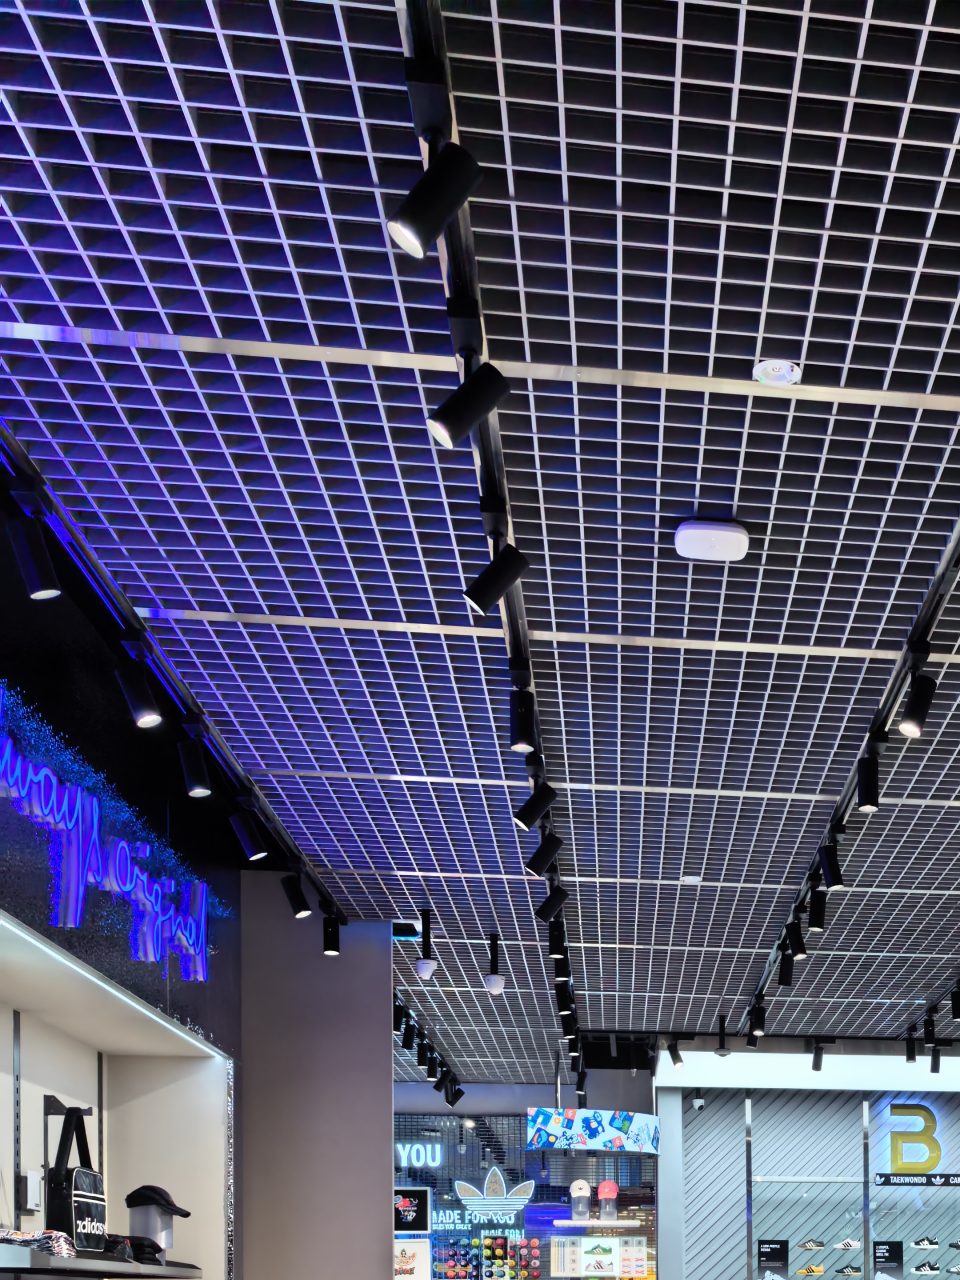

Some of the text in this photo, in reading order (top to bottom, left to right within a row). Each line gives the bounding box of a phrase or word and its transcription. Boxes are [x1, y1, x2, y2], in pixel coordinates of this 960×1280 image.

[396, 1143, 441, 1167] YOU
[890, 1175, 927, 1184] TAEKWONDO
[76, 1216, 105, 1236] adidas
